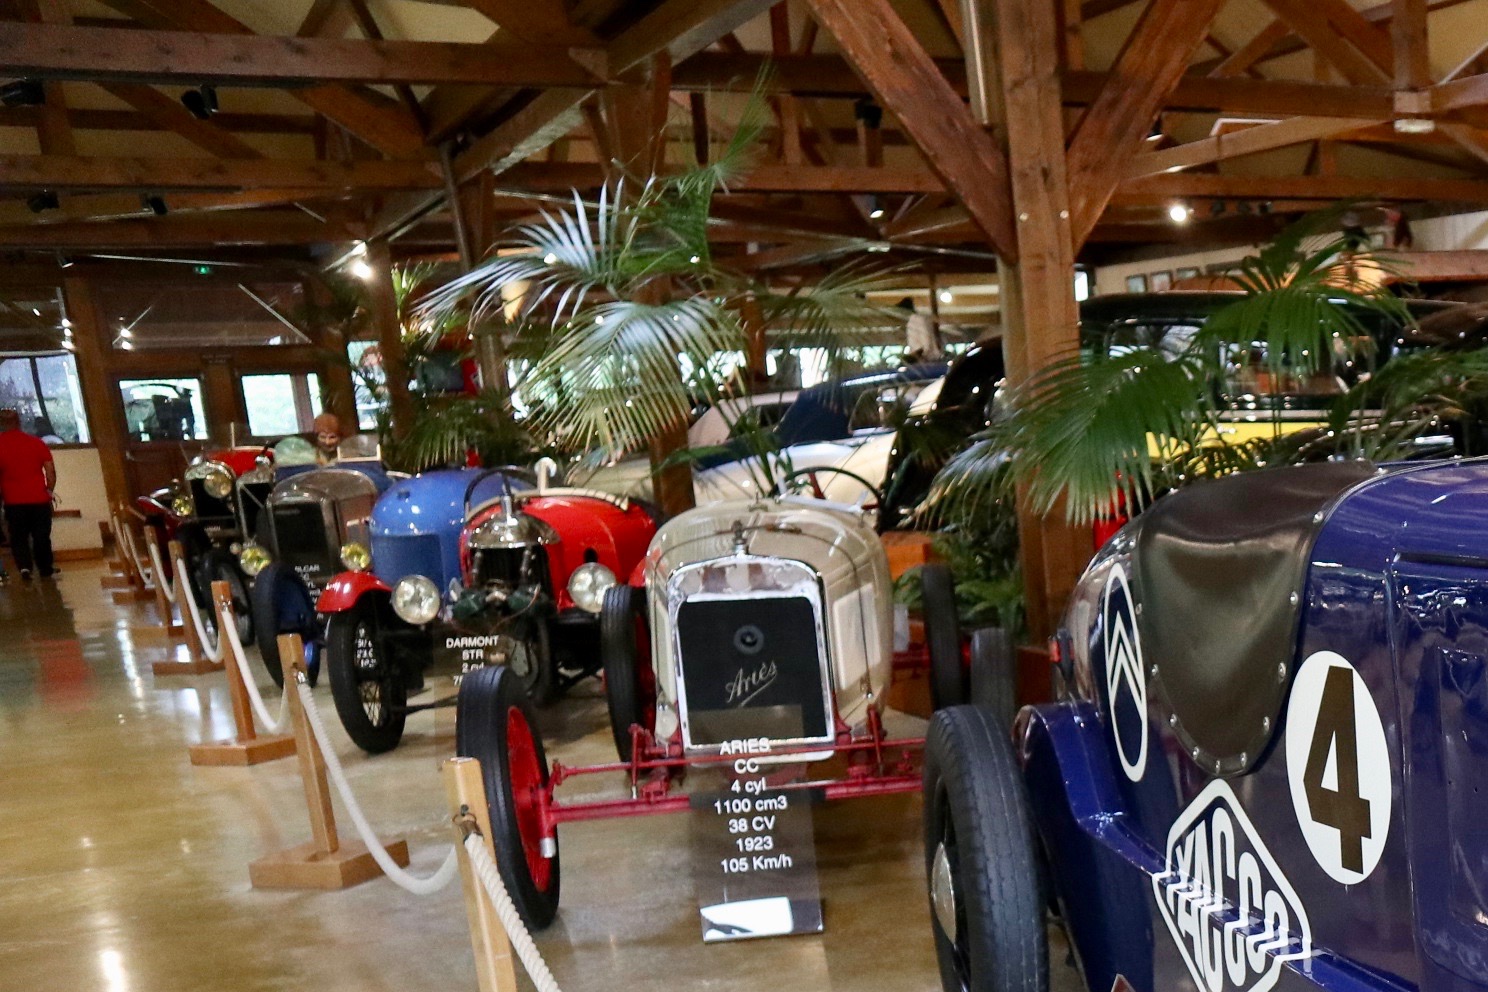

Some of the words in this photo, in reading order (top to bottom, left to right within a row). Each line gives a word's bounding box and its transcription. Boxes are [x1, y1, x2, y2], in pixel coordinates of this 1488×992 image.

[446, 635, 498, 649] DARMONT
[462, 649, 483, 661] STR
[462, 662, 469, 673] 2
[720, 737, 770, 755] ARIES
[735, 757, 759, 774] CC
[1303, 665, 1372, 875] 4
[731, 779, 741, 793] 4
[745, 777, 766, 795] cyl
[714, 798, 751, 814] 1100
[755, 795, 788, 812] cm3
[729, 818, 748, 833] 38
[752, 815, 775, 831] CV
[736, 836, 773, 852] 1923
[721, 858, 748, 873] 105
[752, 854, 793, 871] Km/h
